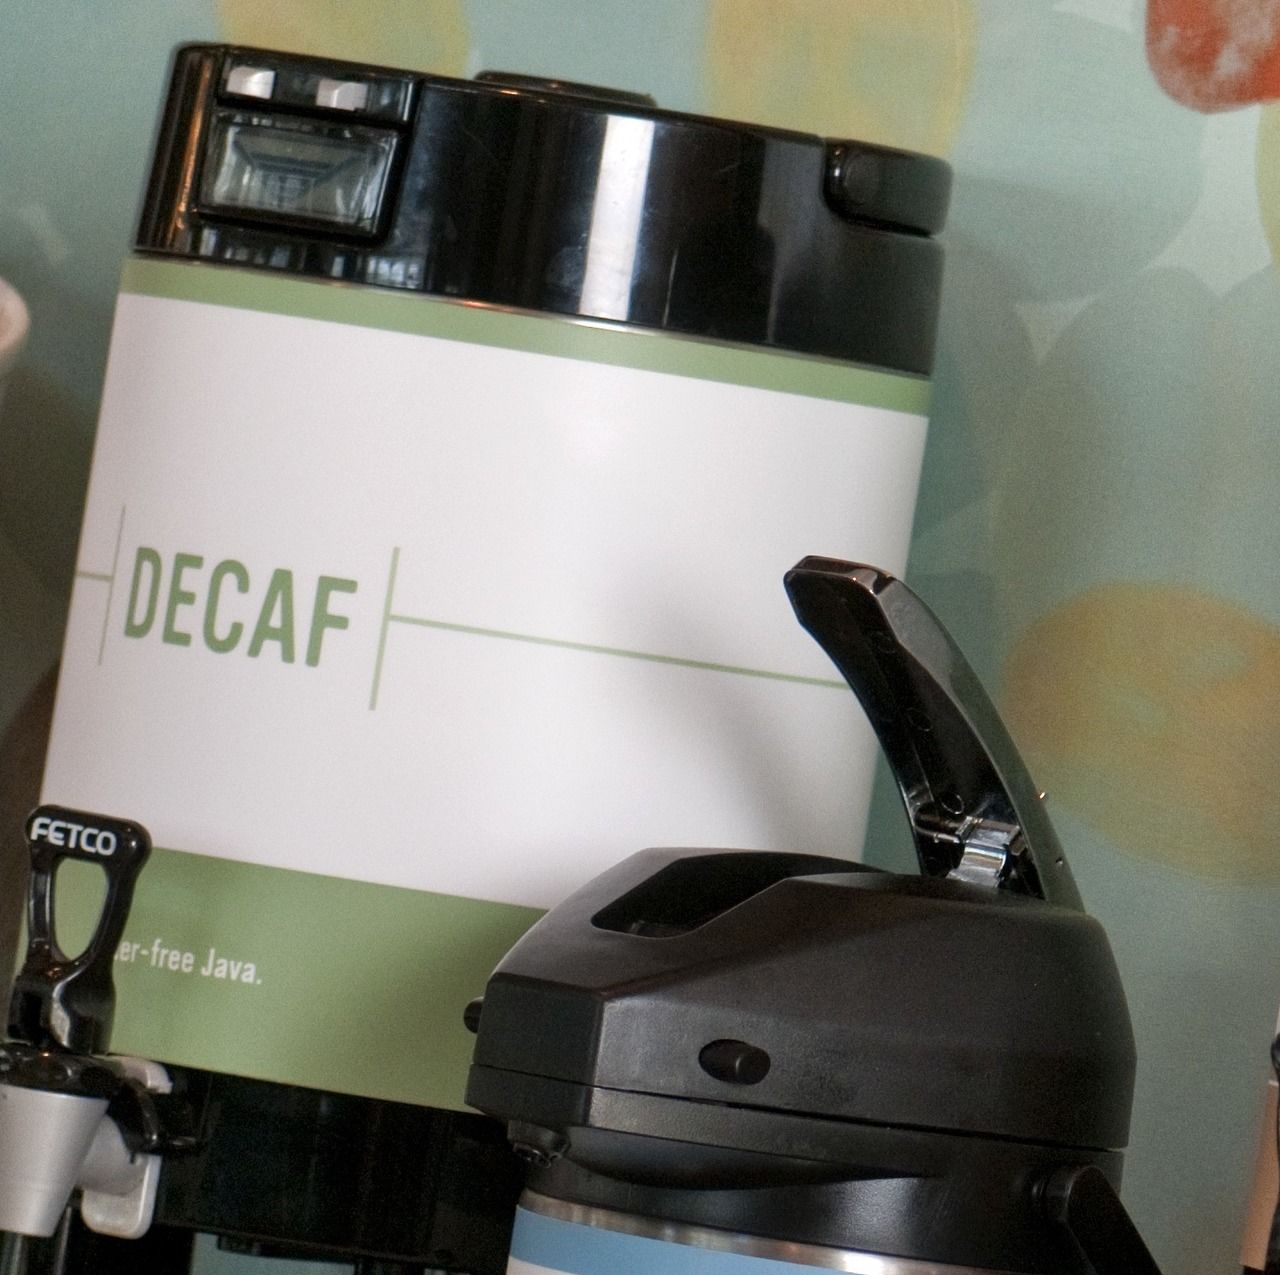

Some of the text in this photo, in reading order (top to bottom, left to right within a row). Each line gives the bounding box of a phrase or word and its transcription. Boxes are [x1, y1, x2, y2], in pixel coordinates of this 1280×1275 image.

[124, 547, 358, 667] DECAF
[30, 817, 117, 856] FETCO
[113, 938, 262, 984] er-free Java.
